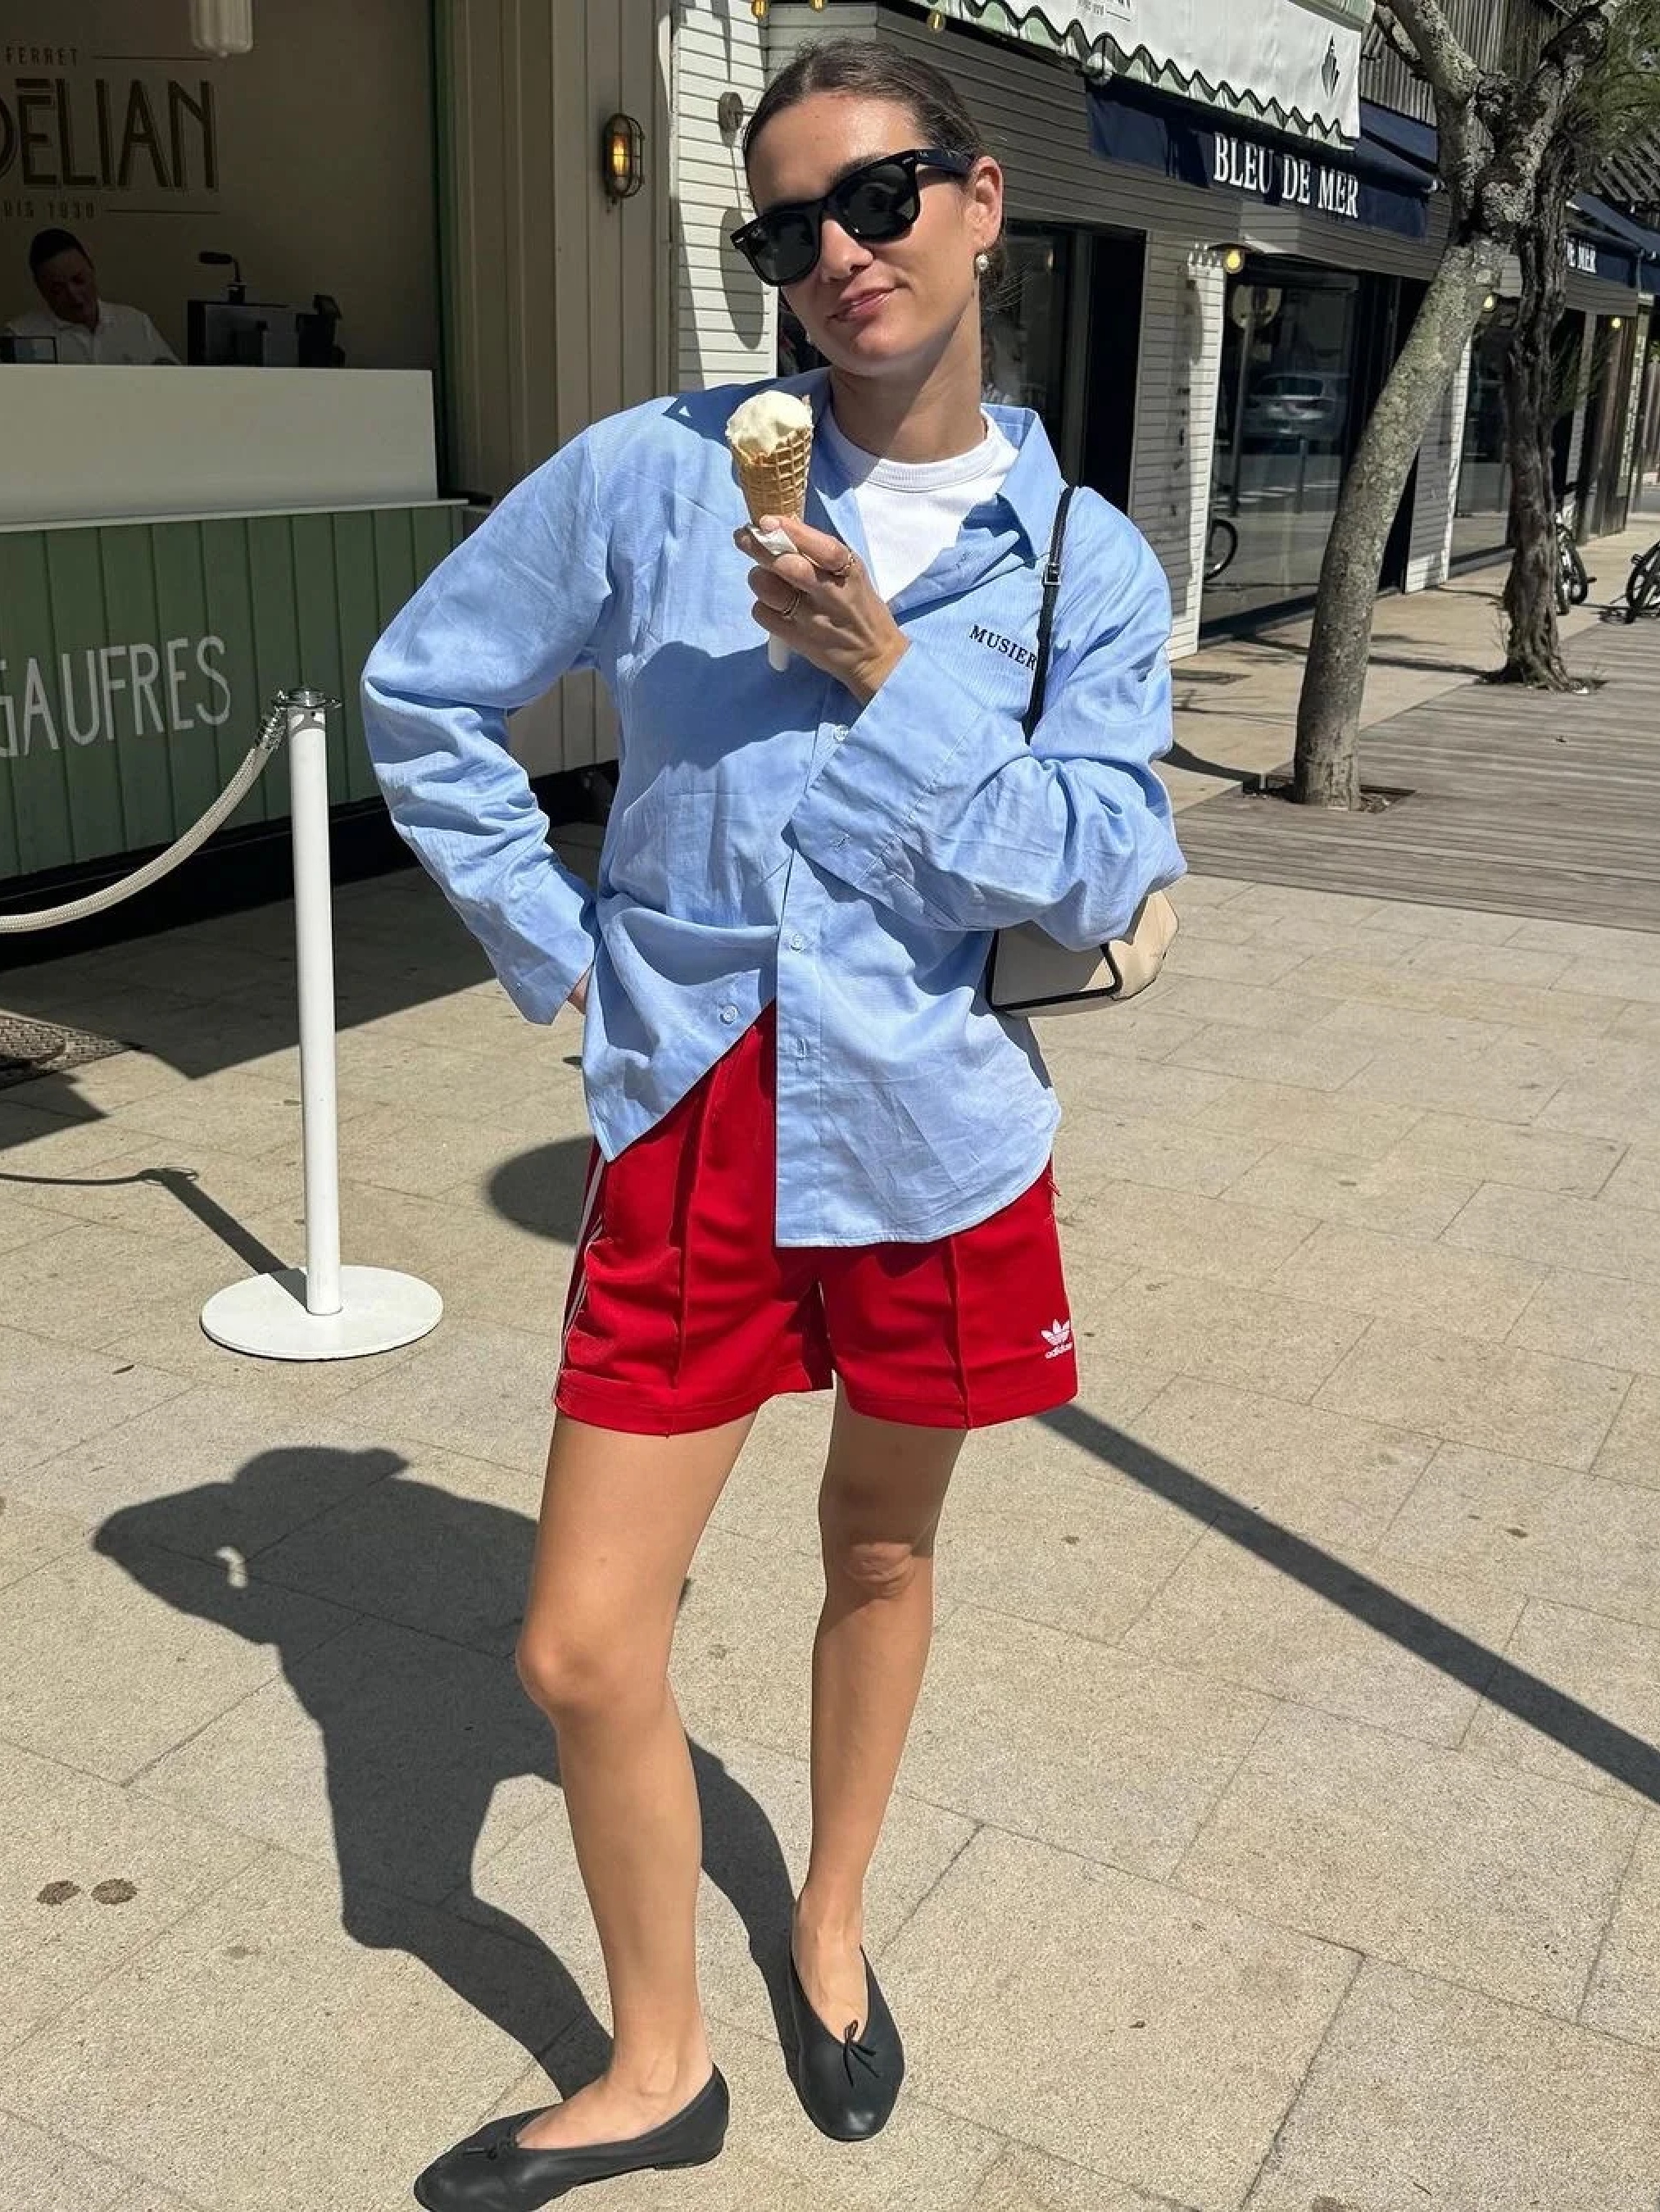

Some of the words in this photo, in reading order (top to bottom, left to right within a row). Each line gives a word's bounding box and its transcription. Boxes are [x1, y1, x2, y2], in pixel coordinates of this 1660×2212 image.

[6, 47, 77, 66] FERRET
[1213, 131, 1274, 194] BLEU
[1281, 153, 1311, 205] DE
[1318, 165, 1358, 219] MER
[969, 623, 1037, 670] MUSIER
